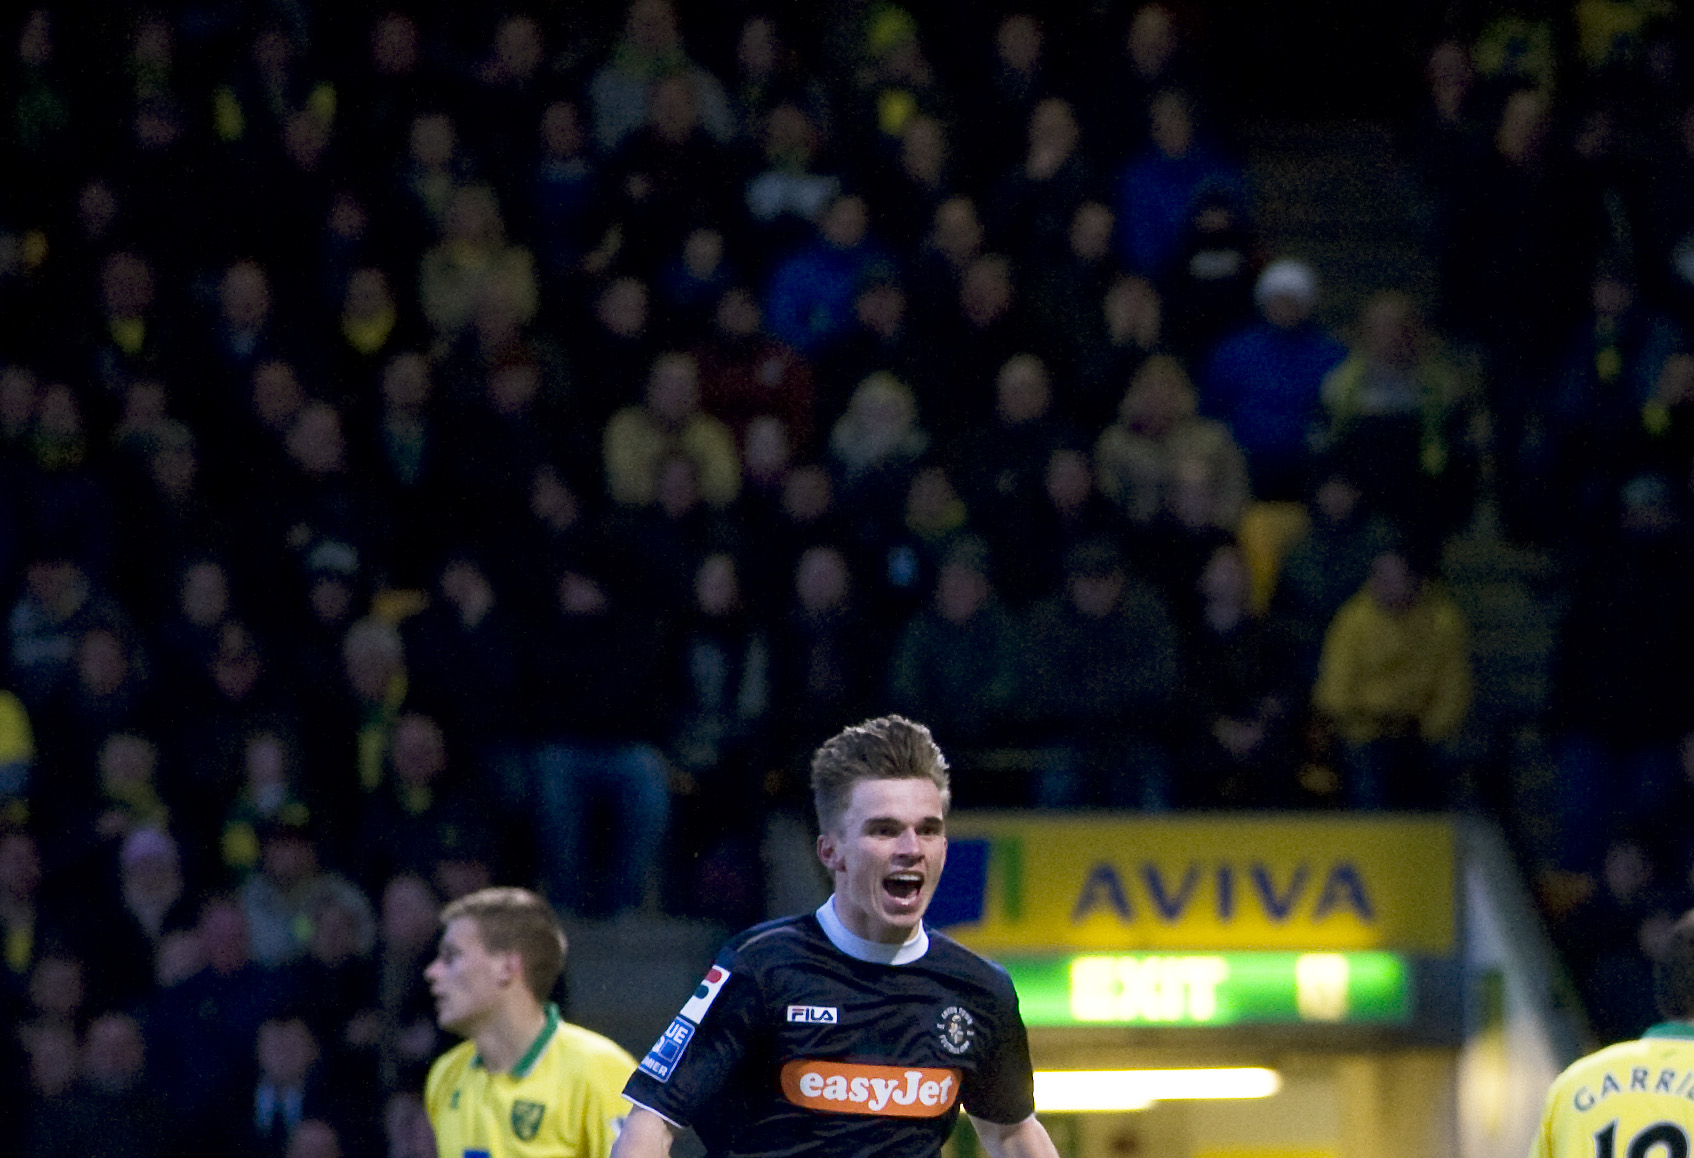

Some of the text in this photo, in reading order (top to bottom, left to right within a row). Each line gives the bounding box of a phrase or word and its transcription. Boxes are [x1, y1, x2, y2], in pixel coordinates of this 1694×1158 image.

[1073, 862, 1374, 922] AVIVA
[1068, 955, 1230, 1022] EXIT
[792, 1008, 834, 1022] FILA
[800, 1071, 953, 1112] easyJet
